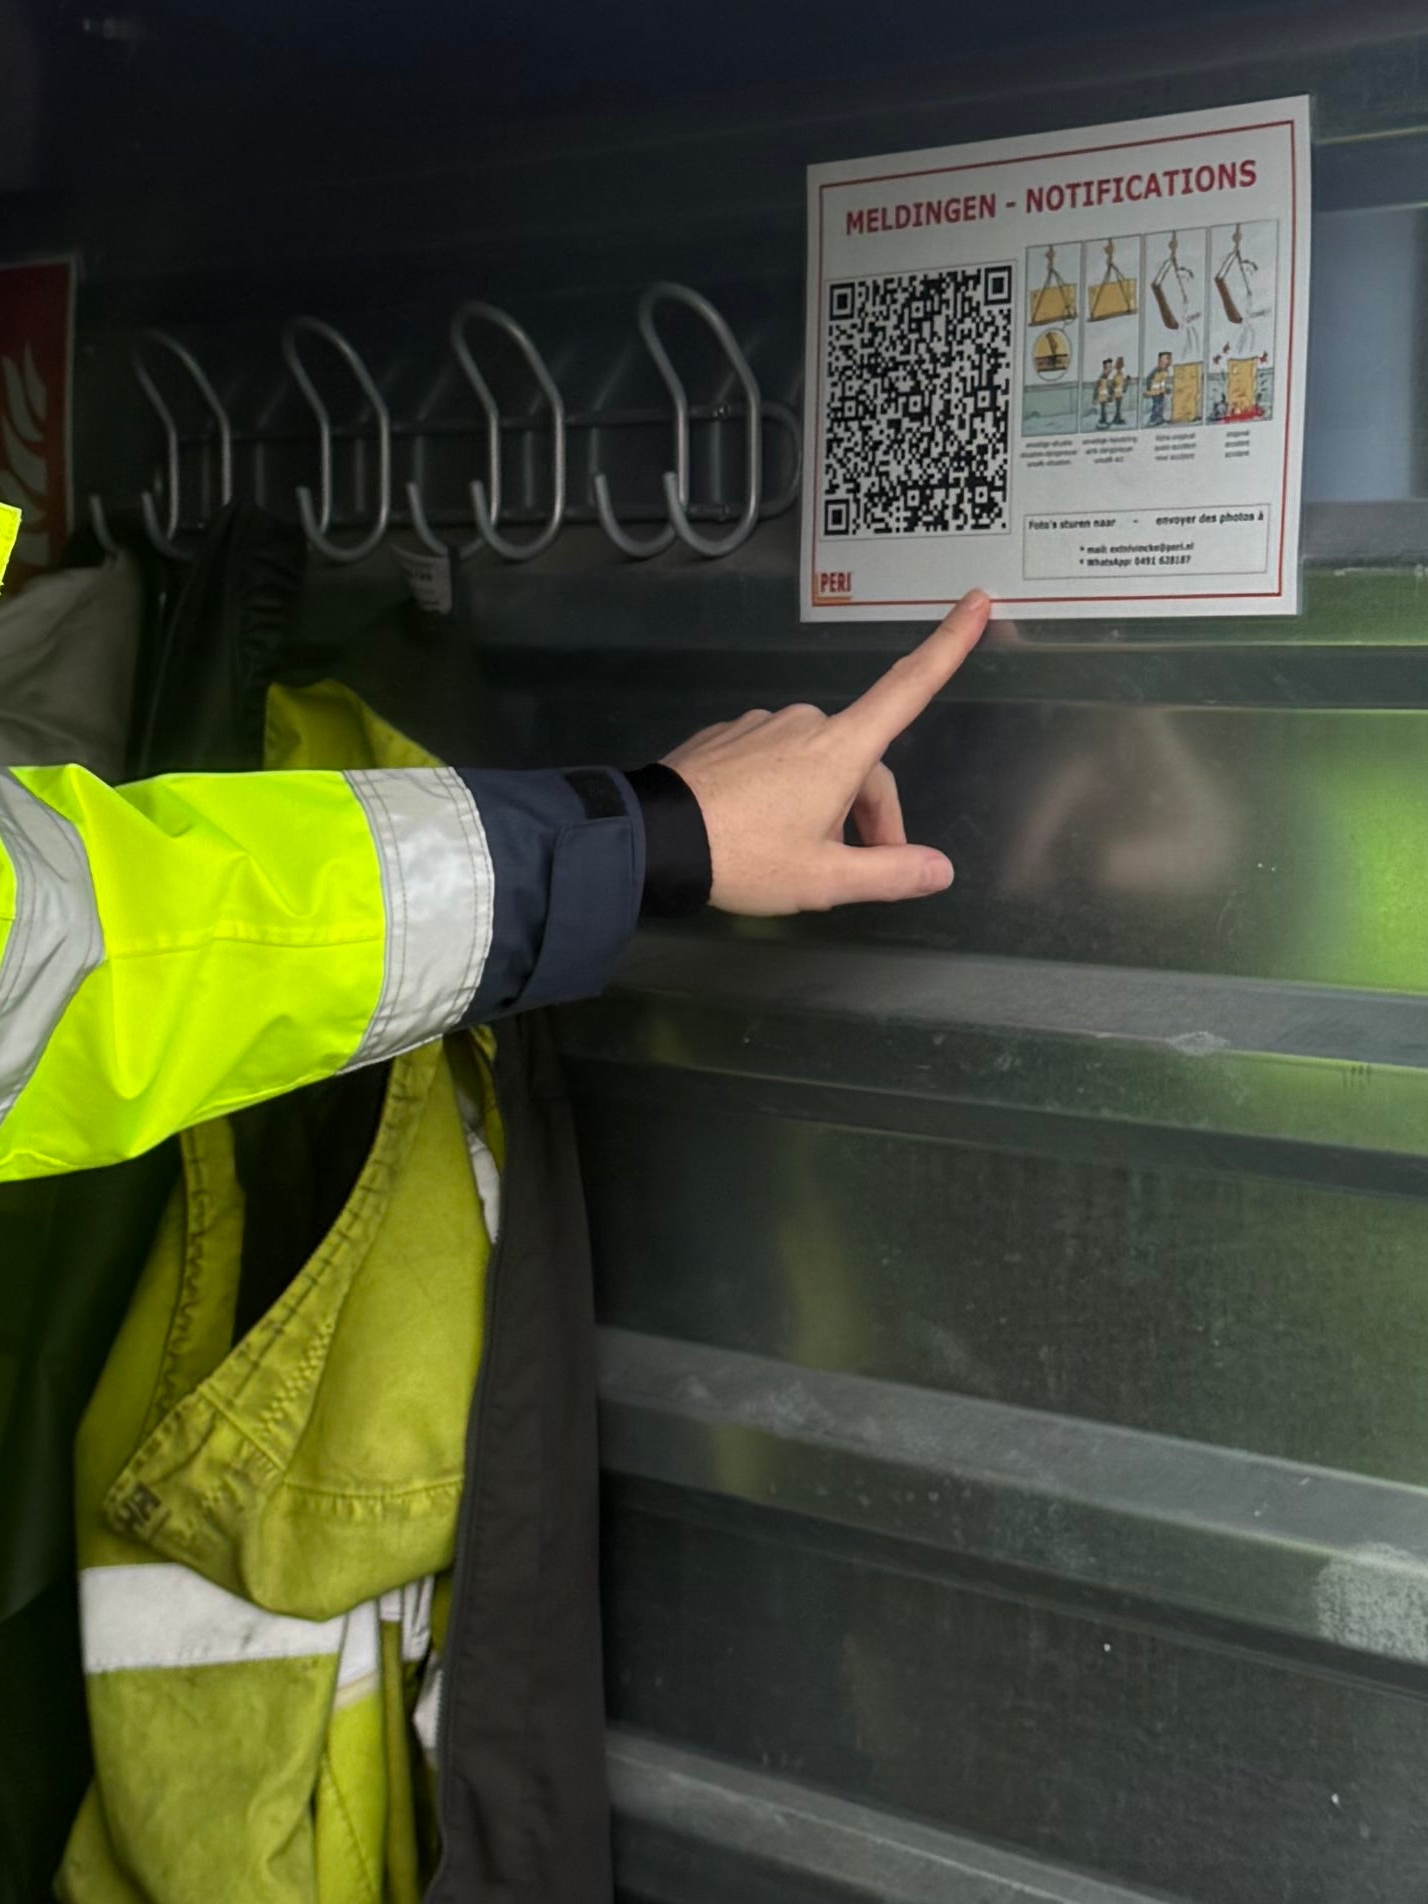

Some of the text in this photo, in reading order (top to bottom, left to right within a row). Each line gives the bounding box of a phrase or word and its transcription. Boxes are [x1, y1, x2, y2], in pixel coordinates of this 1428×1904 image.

[845, 193, 997, 235] MELDINGEN
[1025, 159, 1258, 214] NOTIFICATIONS
[1028, 520, 1057, 530] Foto's
[1060, 519, 1091, 529] sturen
[1093, 518, 1116, 528] naar
[1156, 514, 1196, 527] envoyer
[1199, 513, 1217, 524] des
[1219, 512, 1255, 524] photos
[820, 571, 852, 593] PERI
